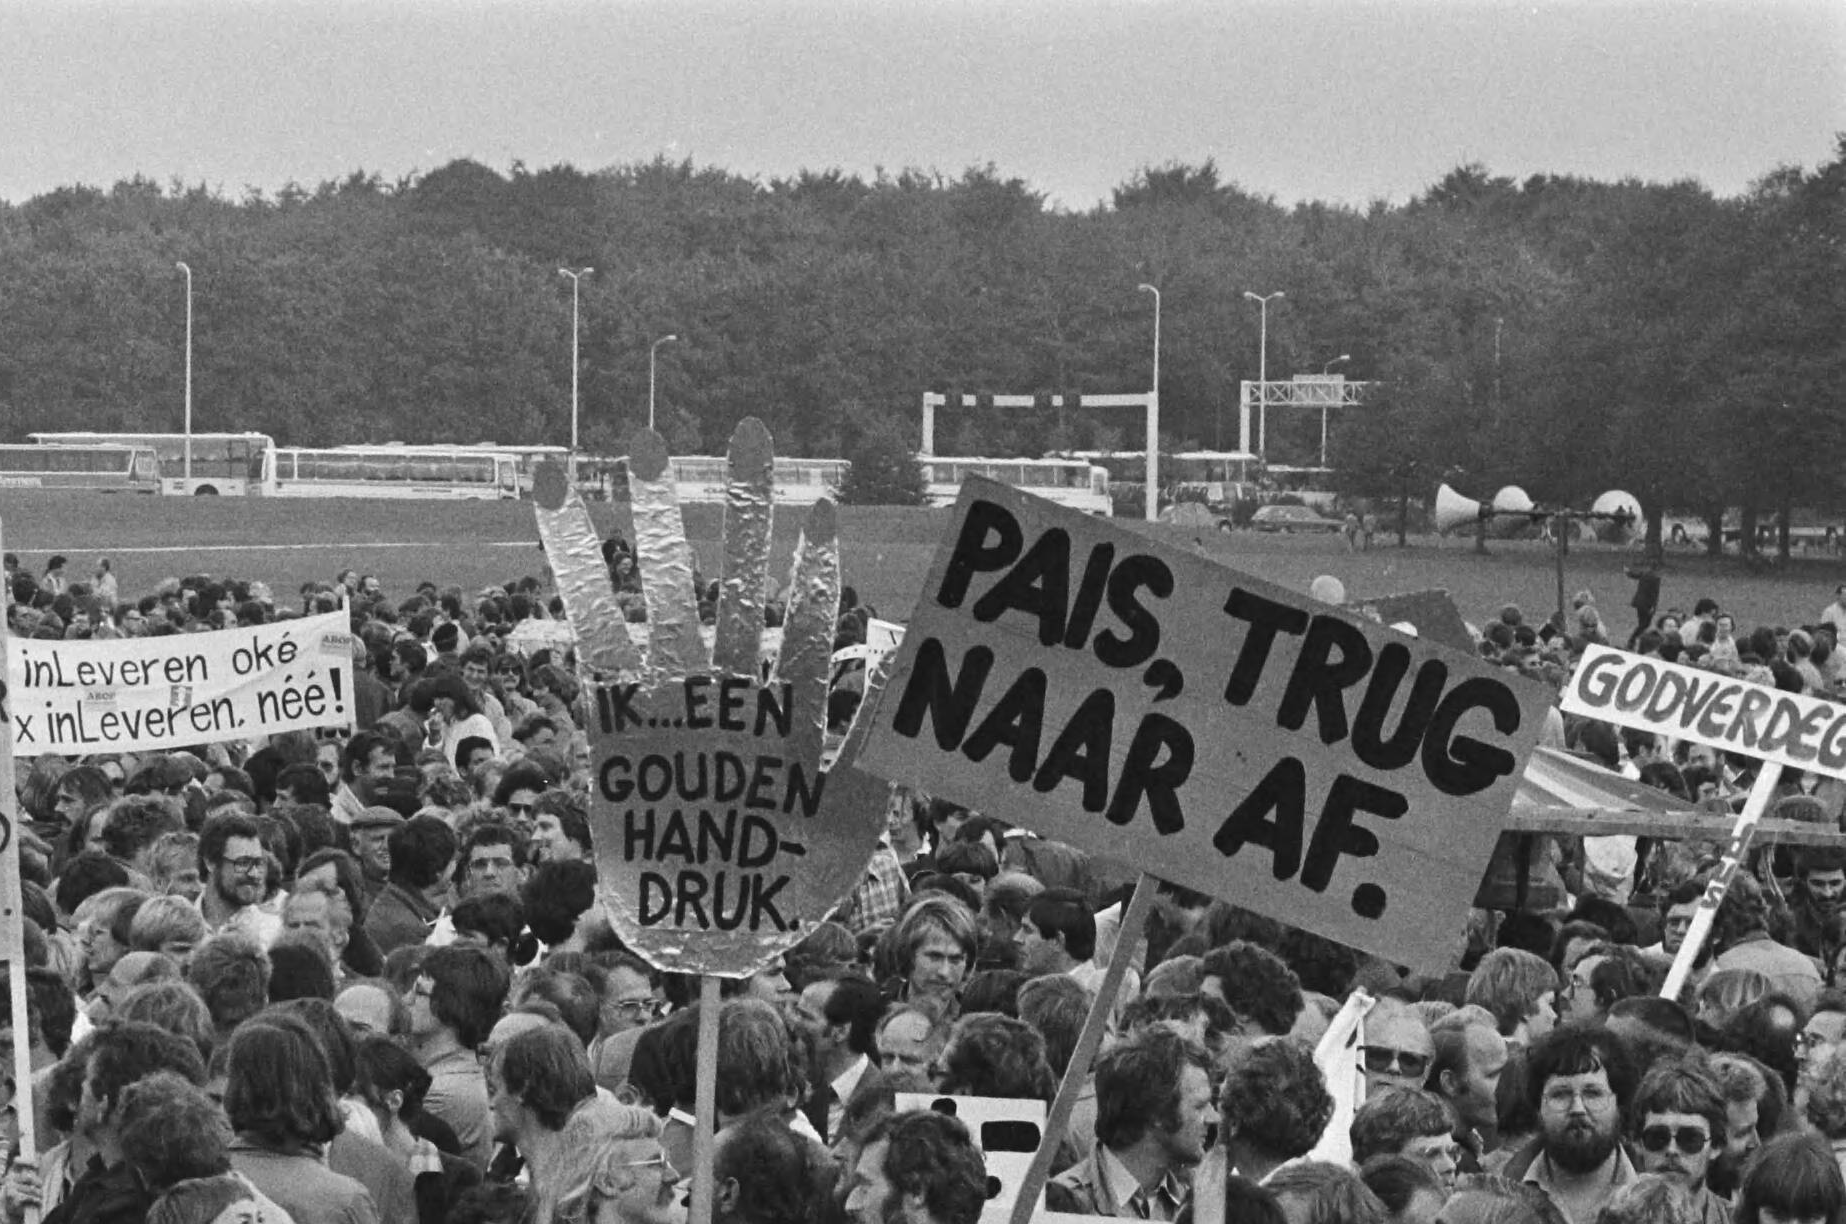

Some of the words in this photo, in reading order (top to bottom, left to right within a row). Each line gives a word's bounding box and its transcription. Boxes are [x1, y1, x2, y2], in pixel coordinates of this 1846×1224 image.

[232, 631, 298, 675] oké
[936, 500, 1183, 702] PAIS,
[1224, 587, 1521, 796] TRUG
[258, 667, 345, 724] néé!
[598, 753, 827, 818] GOUDEN
[893, 638, 1195, 836] NAAR
[1213, 757, 1410, 920] AF.
[624, 810, 806, 869] HAND-
[638, 870, 801, 934] DRUK.
